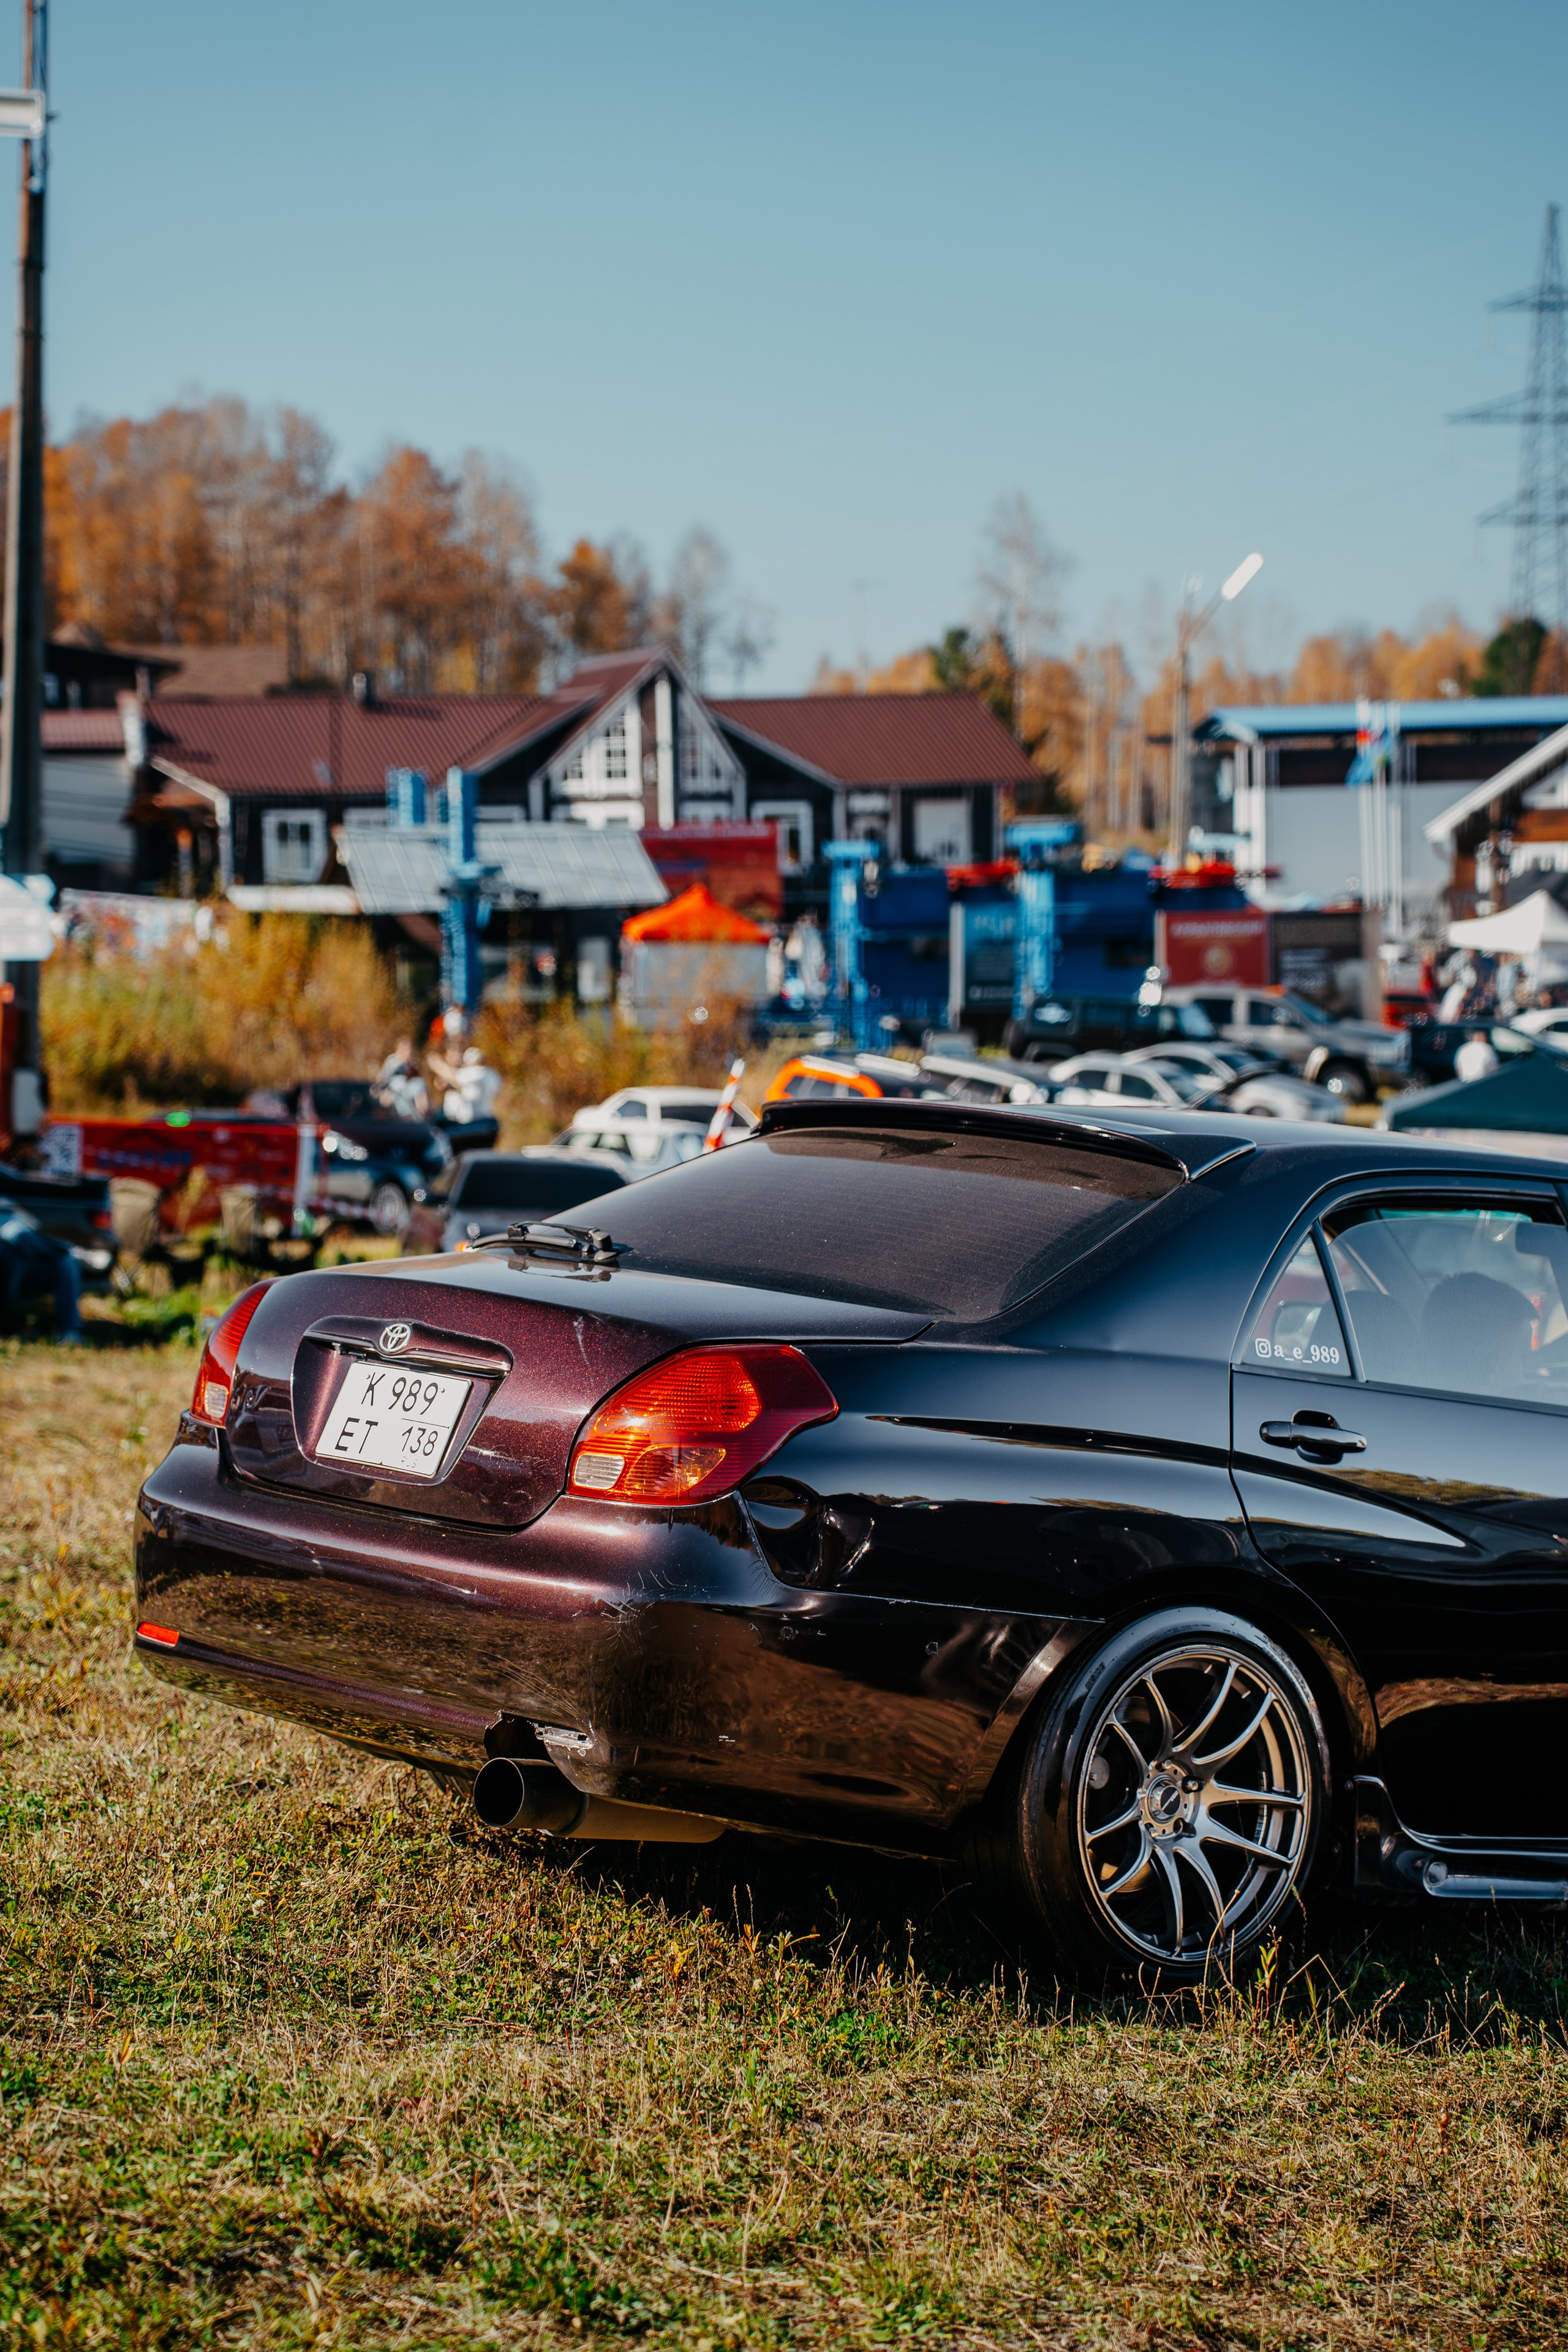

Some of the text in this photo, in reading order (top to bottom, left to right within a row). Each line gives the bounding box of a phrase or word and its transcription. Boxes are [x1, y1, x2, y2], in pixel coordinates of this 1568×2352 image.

[1273, 1344, 1340, 1364] a_e_989
[388, 1377, 439, 1415] 989
[401, 1425, 439, 1457] 138
